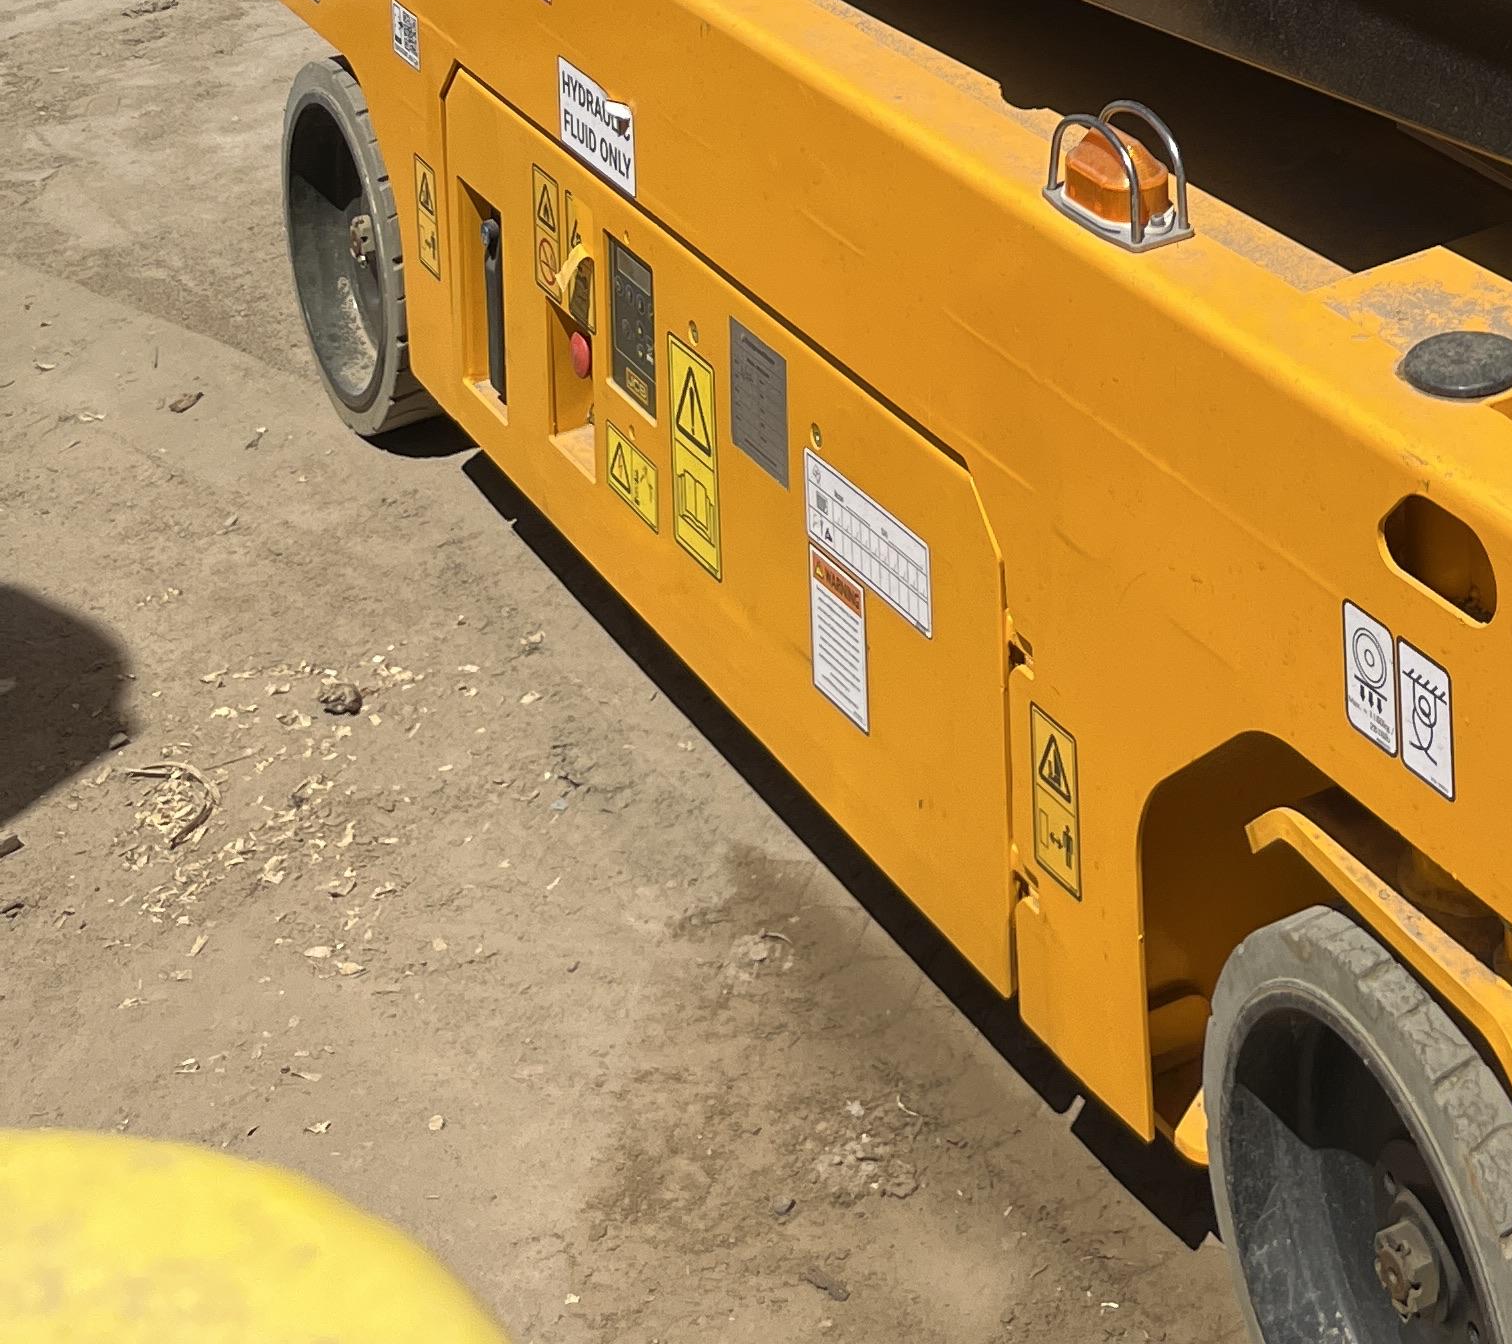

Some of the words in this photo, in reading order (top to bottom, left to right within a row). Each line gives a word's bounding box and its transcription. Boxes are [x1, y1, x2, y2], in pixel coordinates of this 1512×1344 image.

[563, 108, 597, 154] FLUID
[599, 137, 632, 180] ONLY
[825, 568, 861, 610] WARNING
